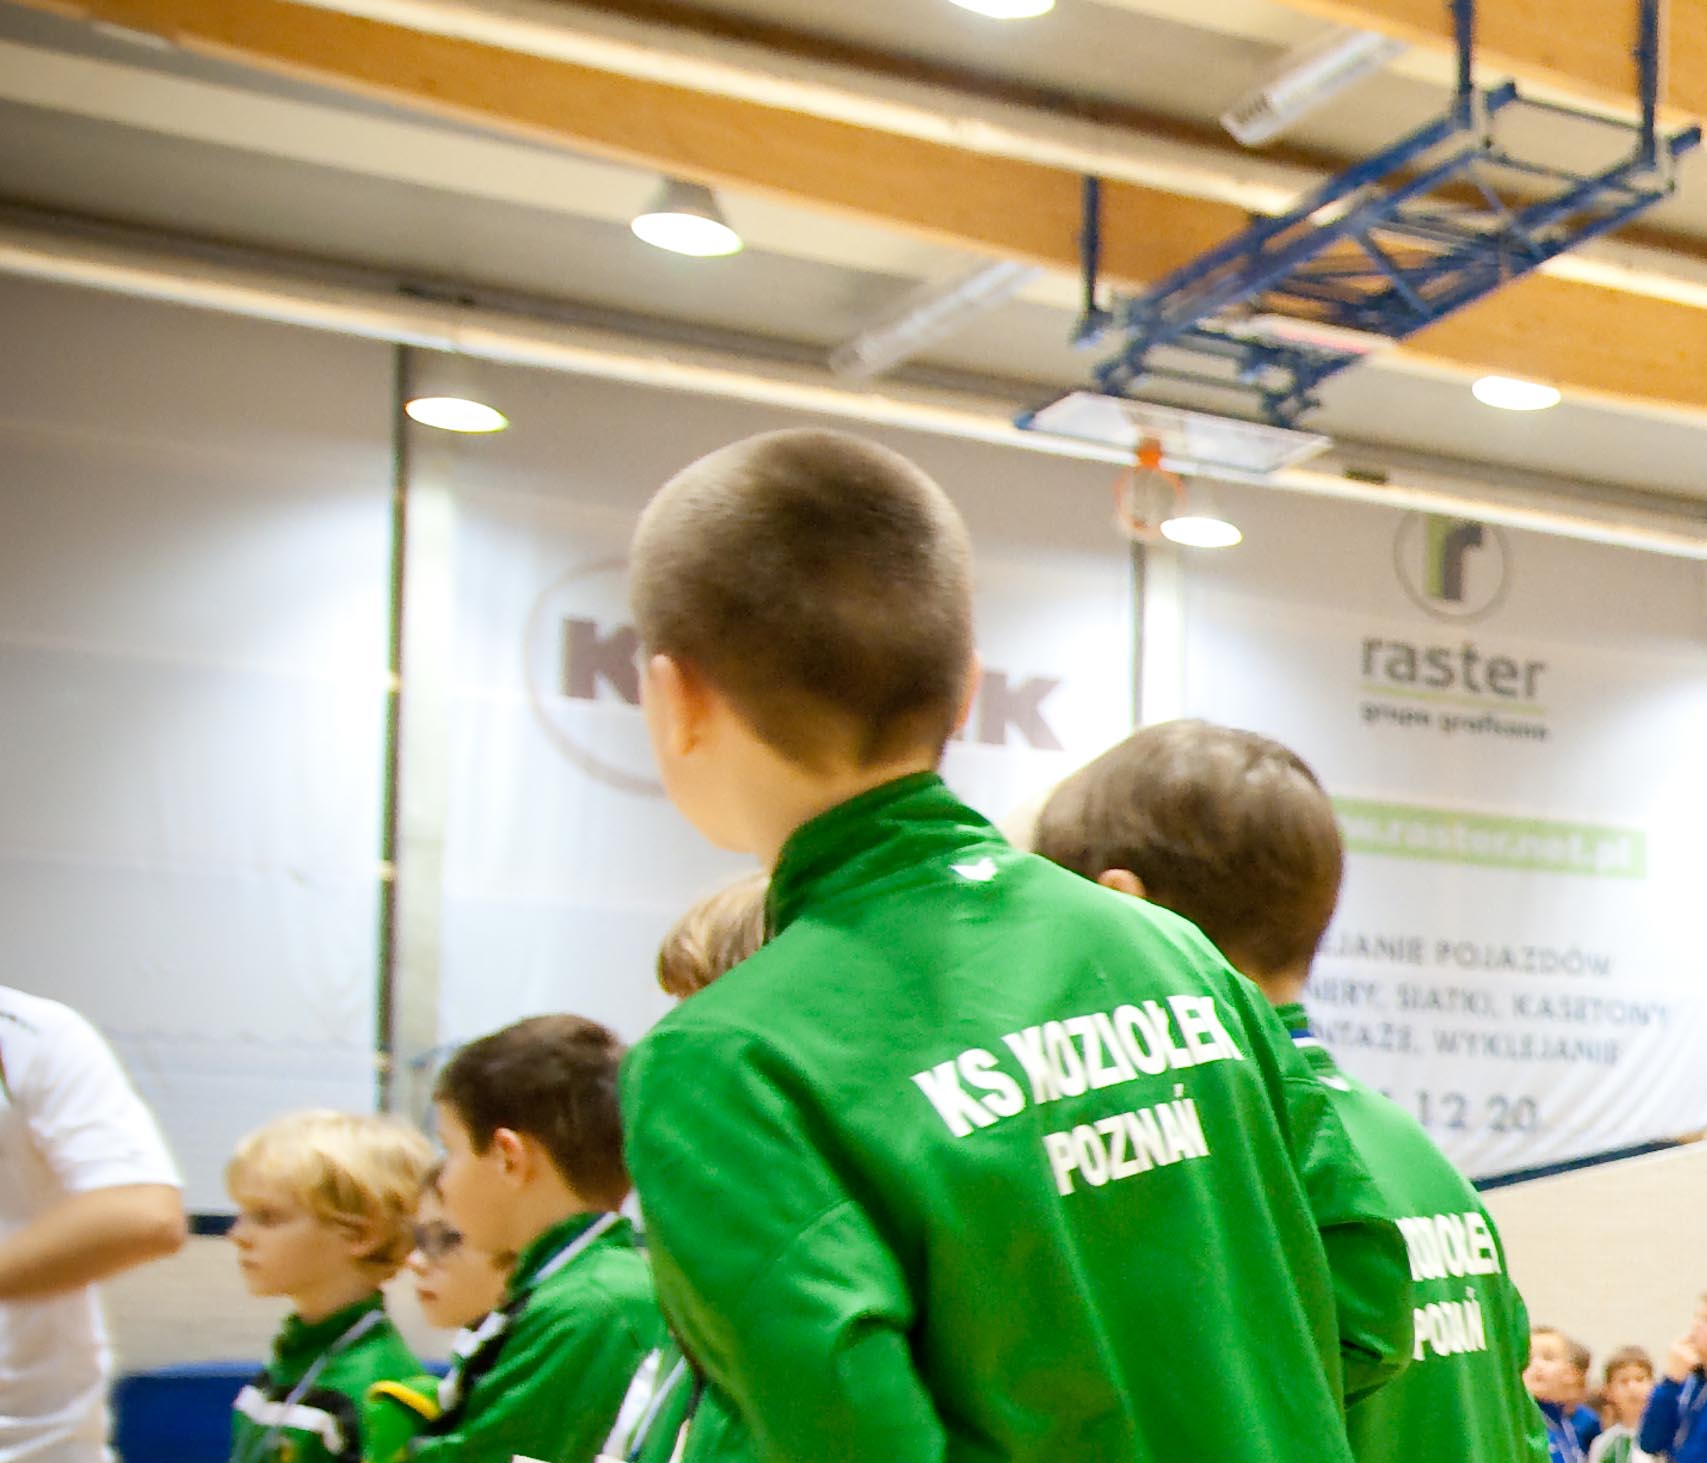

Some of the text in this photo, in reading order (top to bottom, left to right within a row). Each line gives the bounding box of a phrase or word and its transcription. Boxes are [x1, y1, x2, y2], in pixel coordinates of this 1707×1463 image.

[1360, 635, 1548, 697] raster
[911, 995, 1243, 1138] KS KOZIOŁEK
[1430, 1027, 1622, 1068] WYKLEJANIE
[1041, 1082, 1210, 1197] POZNAŃ
[1485, 1092, 1540, 1134] 20
